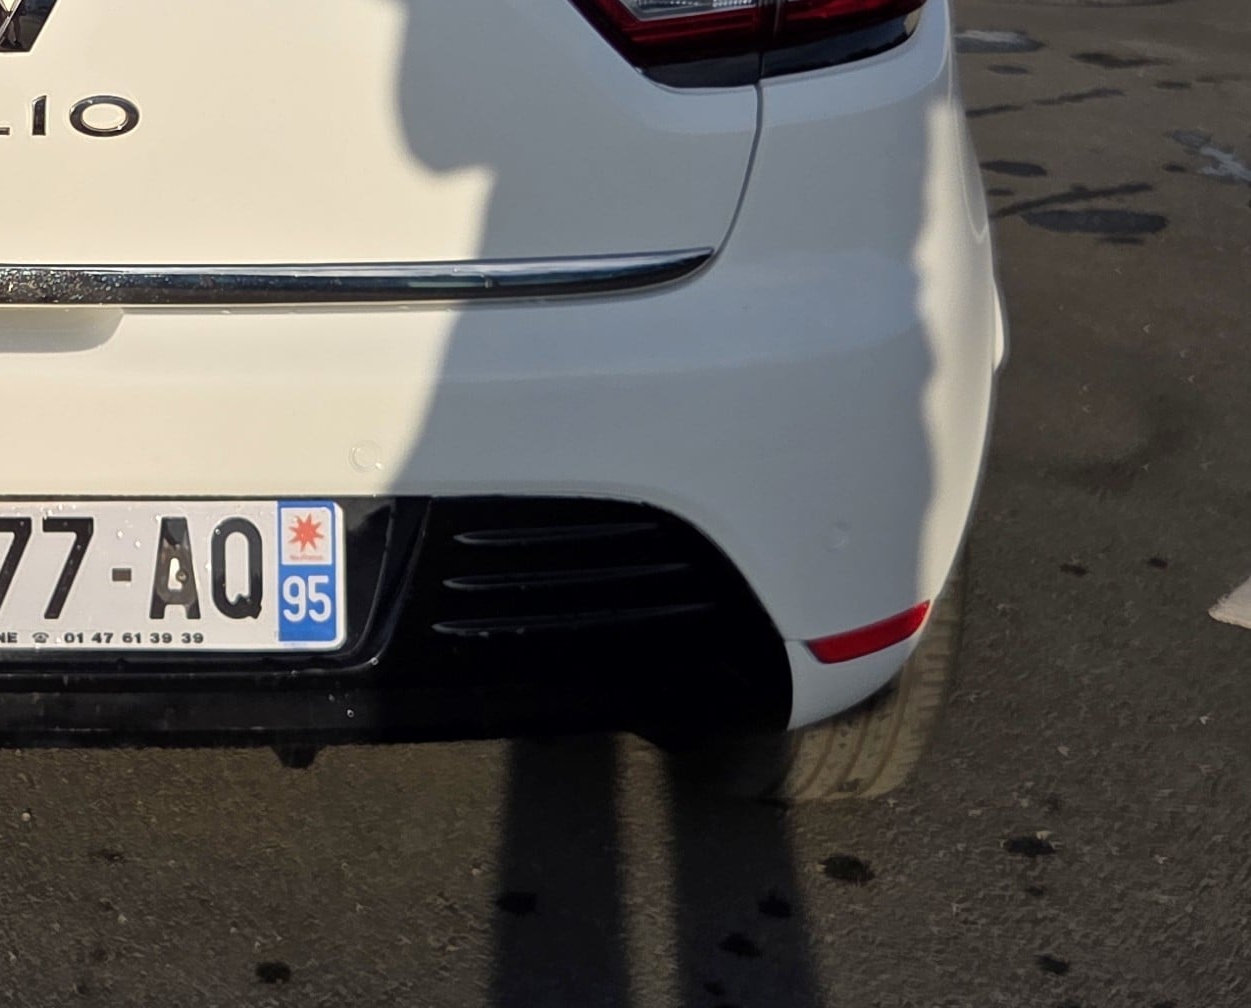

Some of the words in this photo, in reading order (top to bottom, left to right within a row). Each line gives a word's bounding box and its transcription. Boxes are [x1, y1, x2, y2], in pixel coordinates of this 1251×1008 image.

[282, 575, 333, 623] 95
[64, 631, 85, 644] 01
[91, 631, 115, 644] 47
[121, 631, 143, 644] 61
[149, 631, 173, 644] 39
[180, 631, 205, 644] 39
